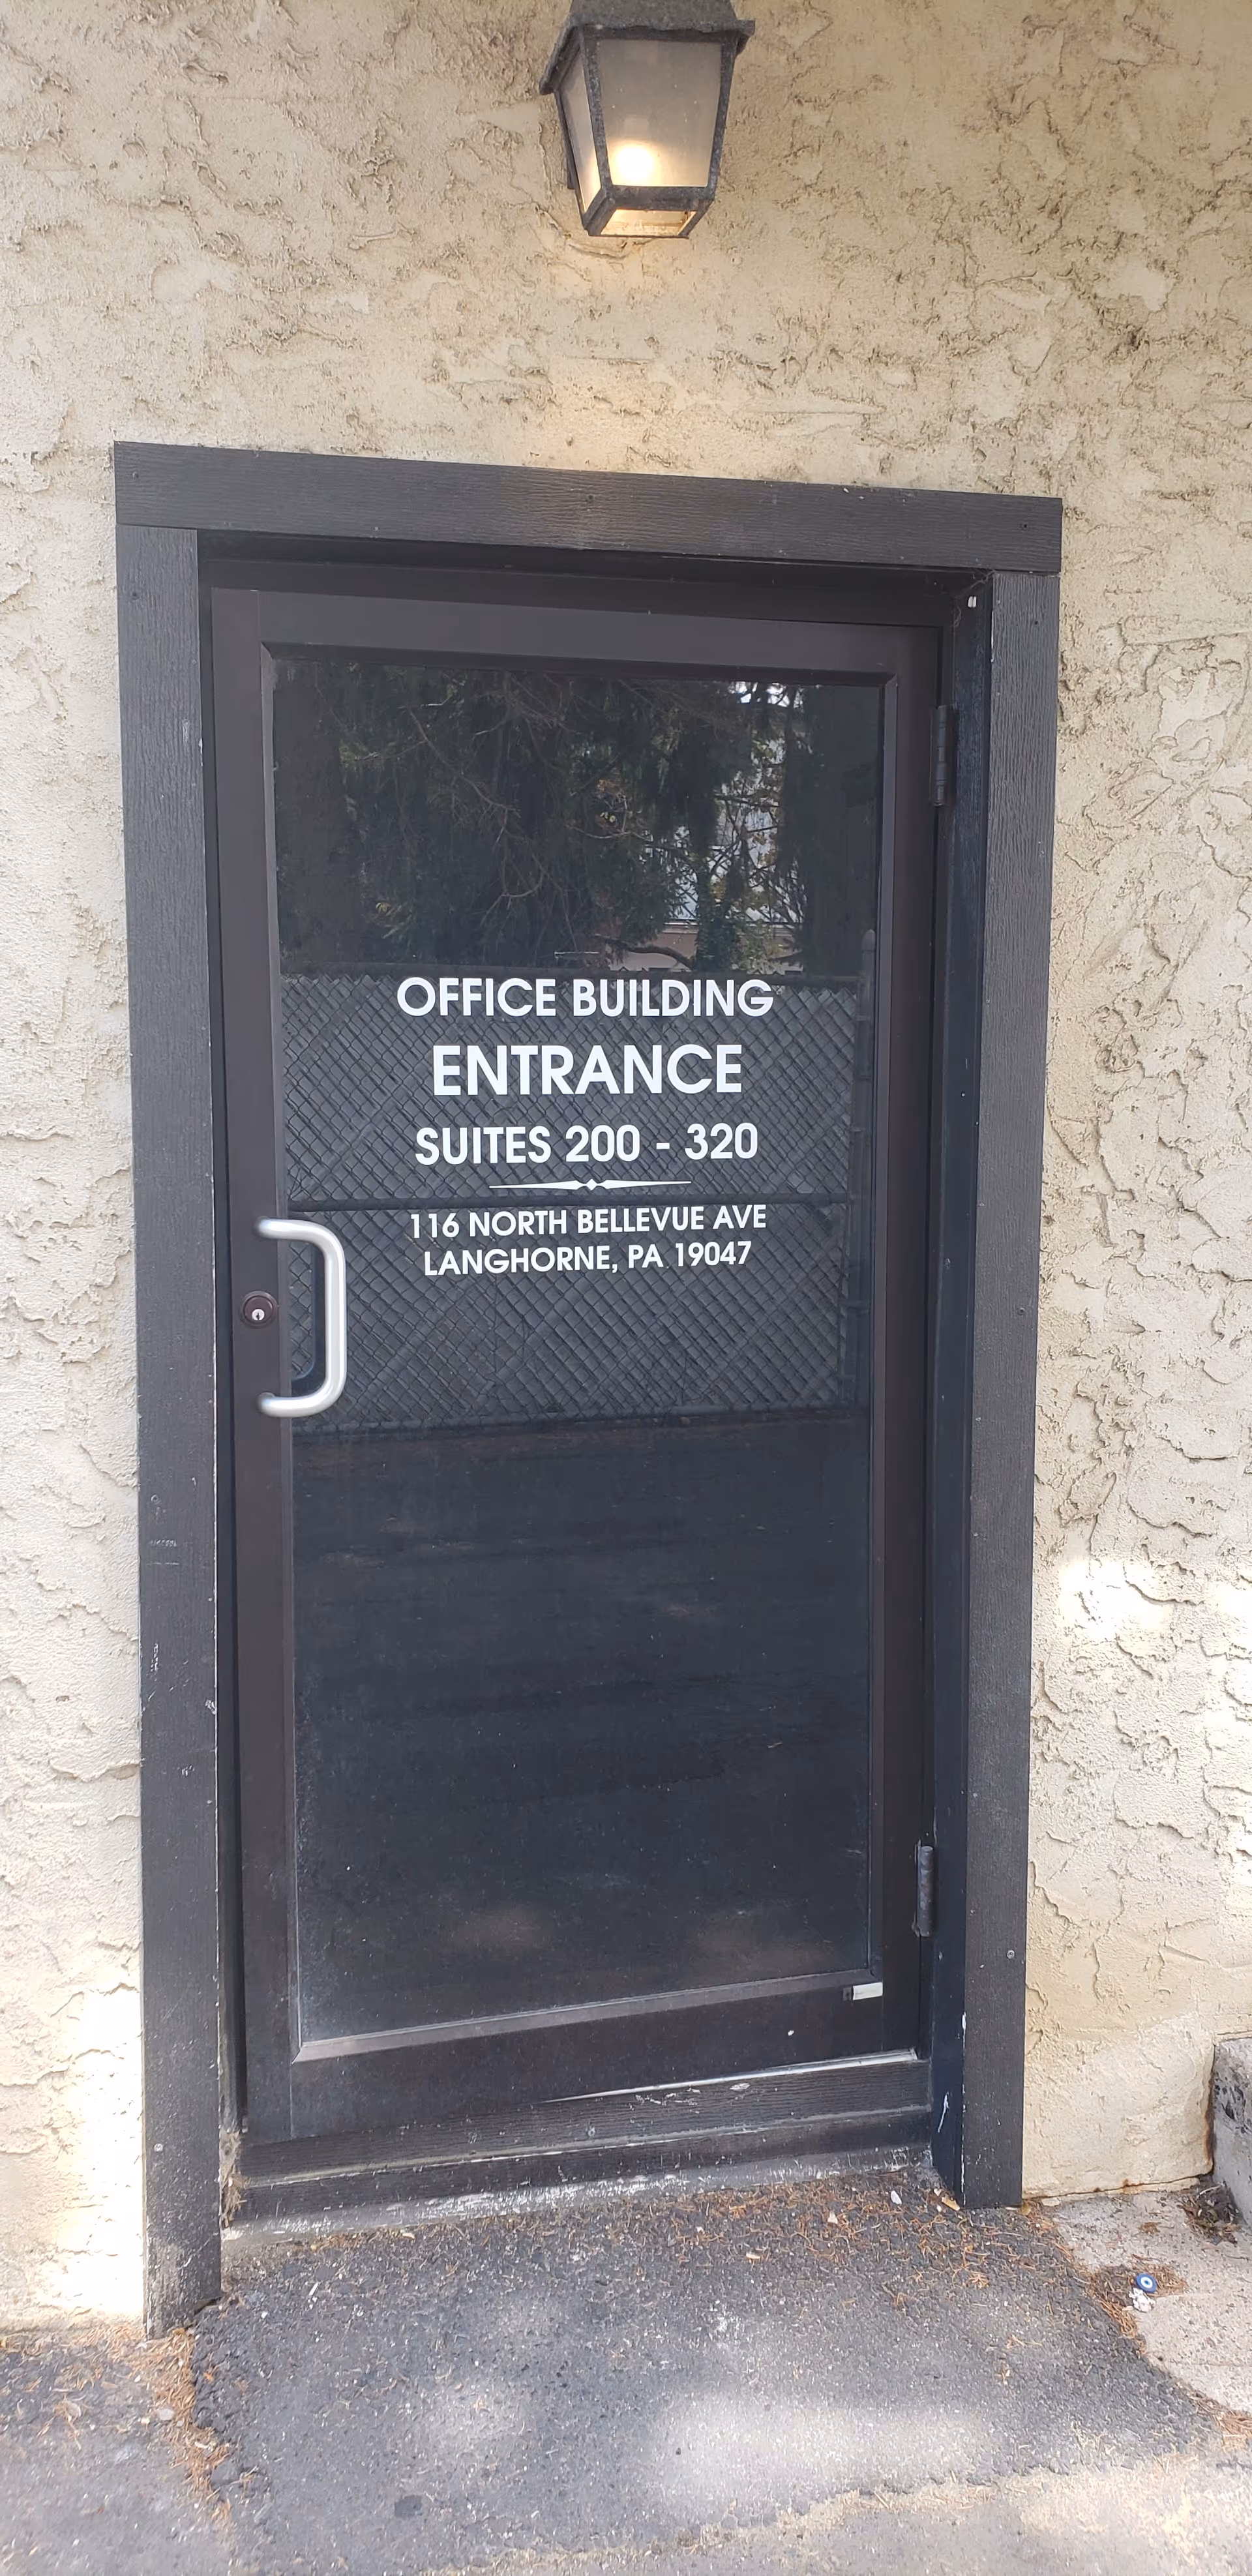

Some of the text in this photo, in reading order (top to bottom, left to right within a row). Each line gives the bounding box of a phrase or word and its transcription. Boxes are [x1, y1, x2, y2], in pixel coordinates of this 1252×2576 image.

[396, 976, 774, 1017] OFFICE BUILDING
[432, 1043, 742, 1096] ENTRANCE
[415, 1124, 552, 1165] SUITES
[565, 1124, 640, 1162] 200
[684, 1122, 758, 1160] 320
[410, 1204, 766, 1238] 116 NORTH BELLEVUE AVE
[424, 1240, 752, 1276] LANGHORNE, PA 19047
